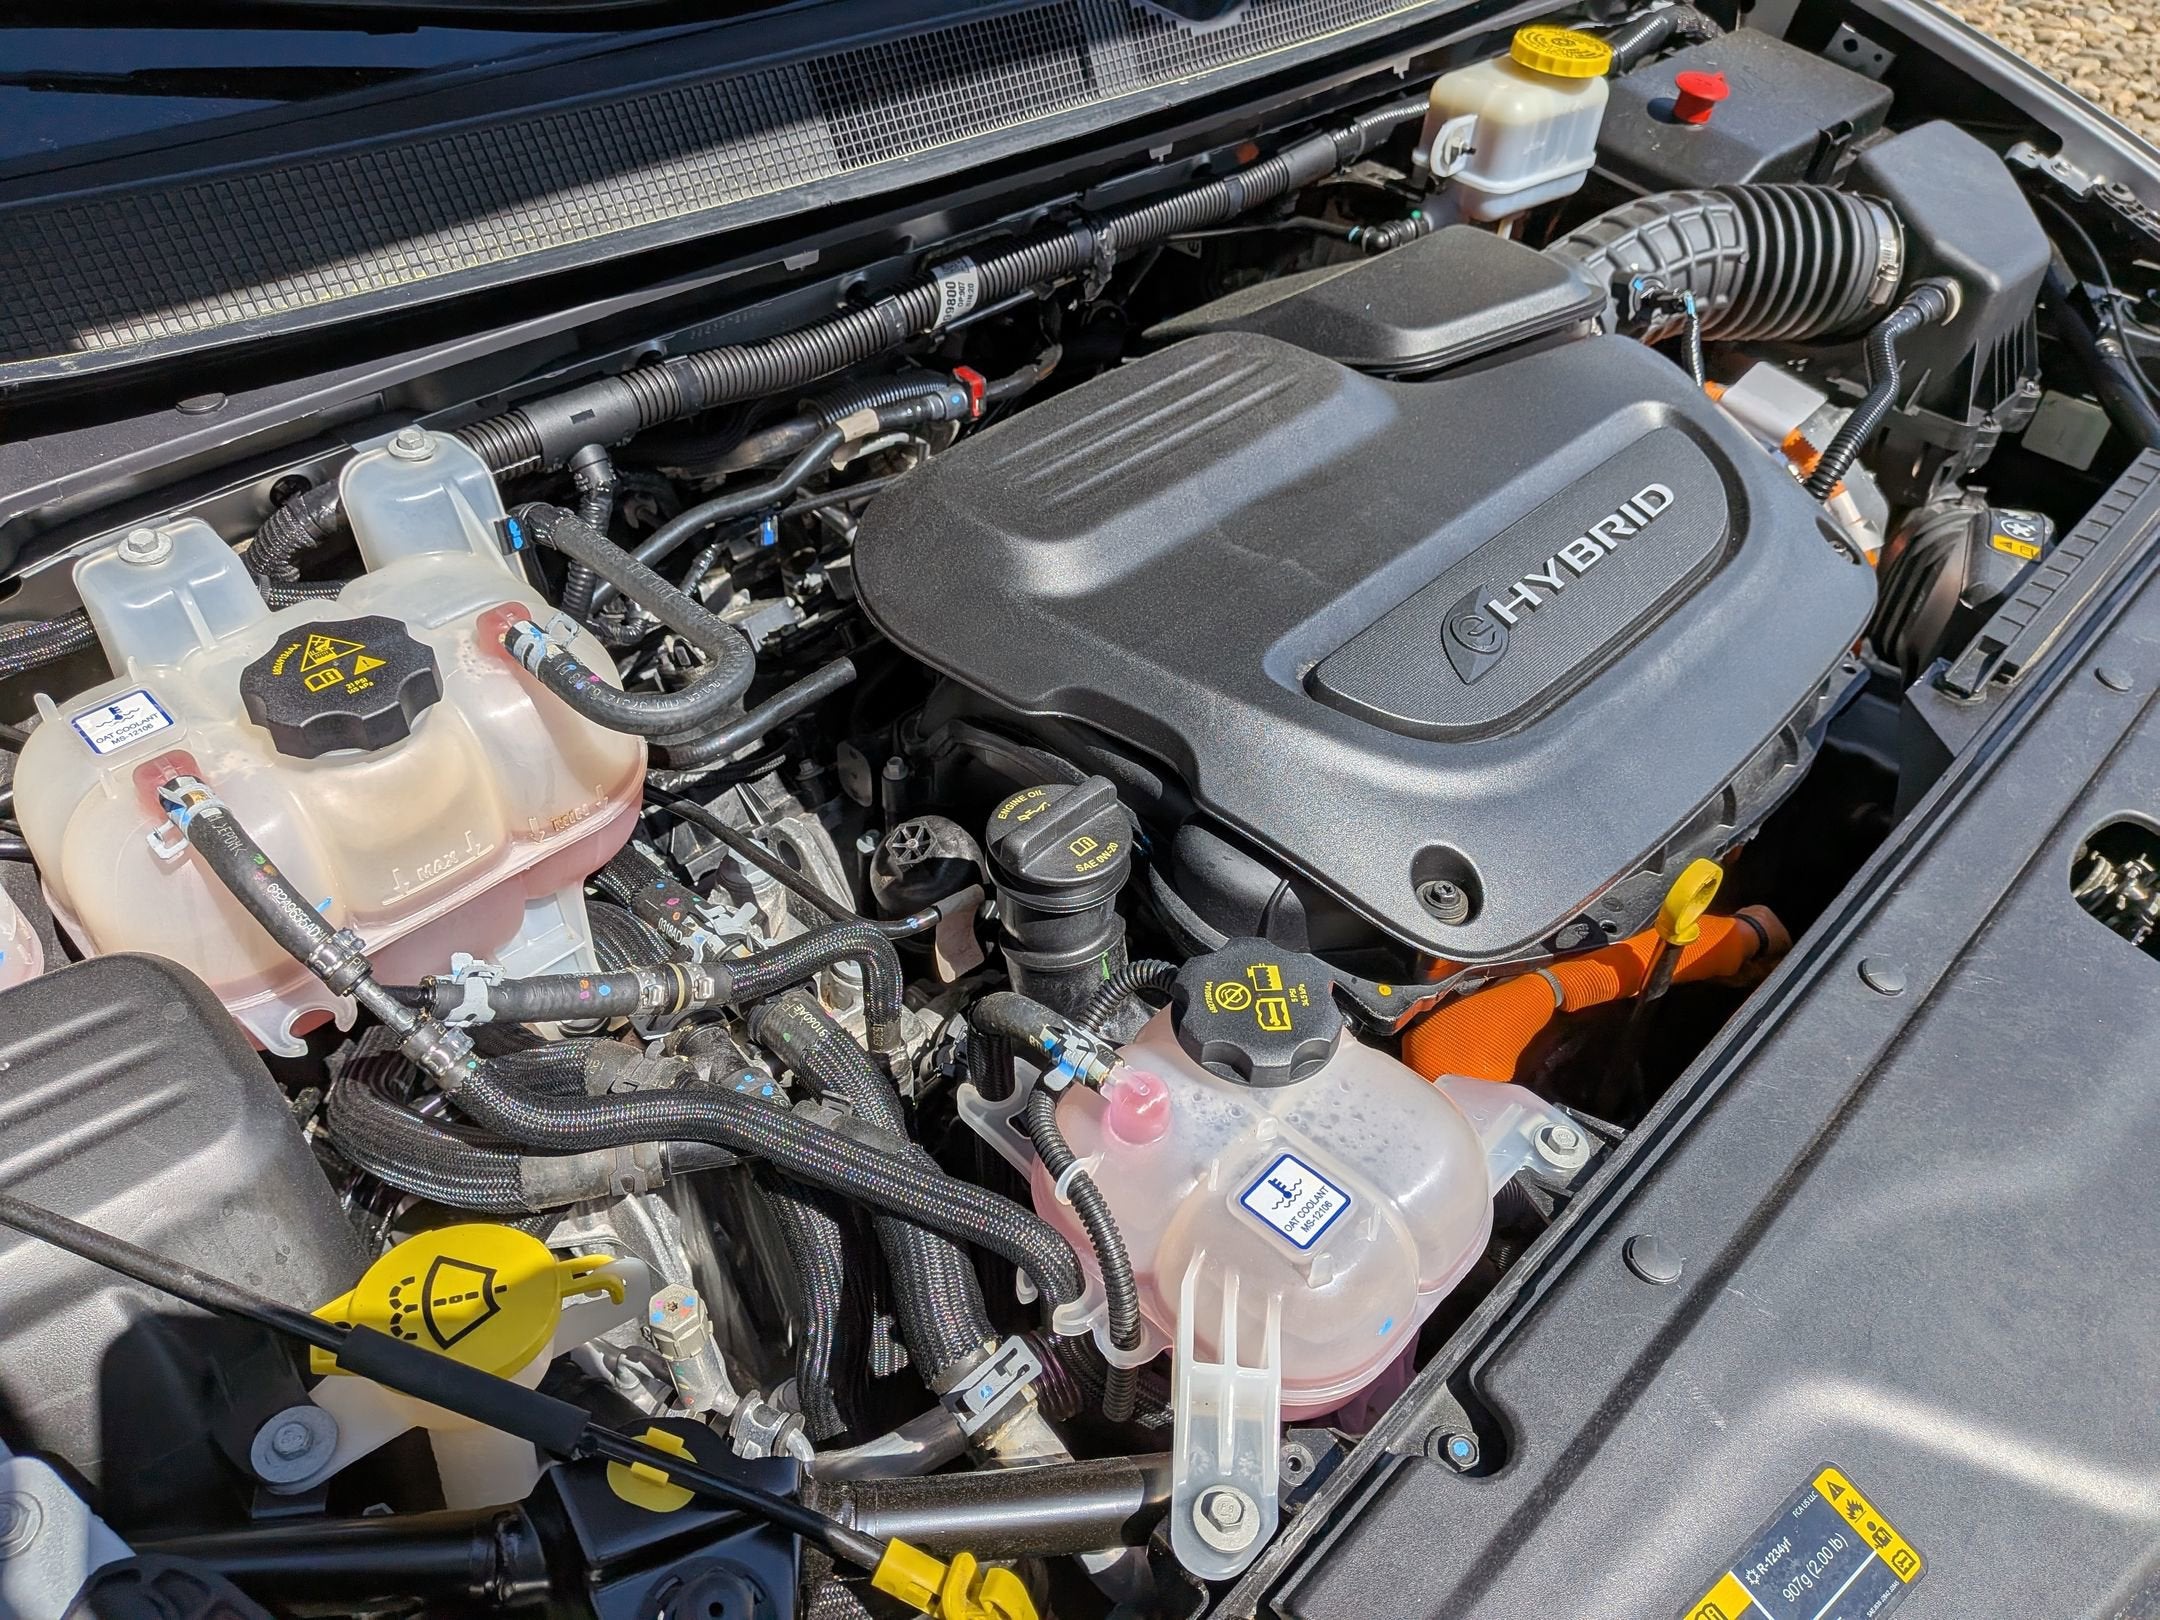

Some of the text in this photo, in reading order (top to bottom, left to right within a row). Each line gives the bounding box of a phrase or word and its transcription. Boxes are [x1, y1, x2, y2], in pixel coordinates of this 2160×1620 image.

[1486, 483, 1675, 626] HYBRID
[354, 677, 368, 686] PSI
[358, 681, 374, 690] kPa
[95, 713, 158, 744] OAT COOLANT
[111, 723, 154, 745] MS-12106
[997, 789, 1046, 820] ENGINE OIL
[416, 850, 460, 882] MAX
[1075, 842, 1119, 873] SAE 0W-20
[1288, 988, 1297, 997] PSI
[1284, 1185, 1329, 1232] OAT COOLANT
[1300, 1200, 1333, 1233] MS-12106
[1792, 1490, 1819, 1518] FCA US LLC
[1756, 1536, 1792, 1575] R-1234yf
[1782, 1532, 1849, 1602] 907g (2.00 lb)
